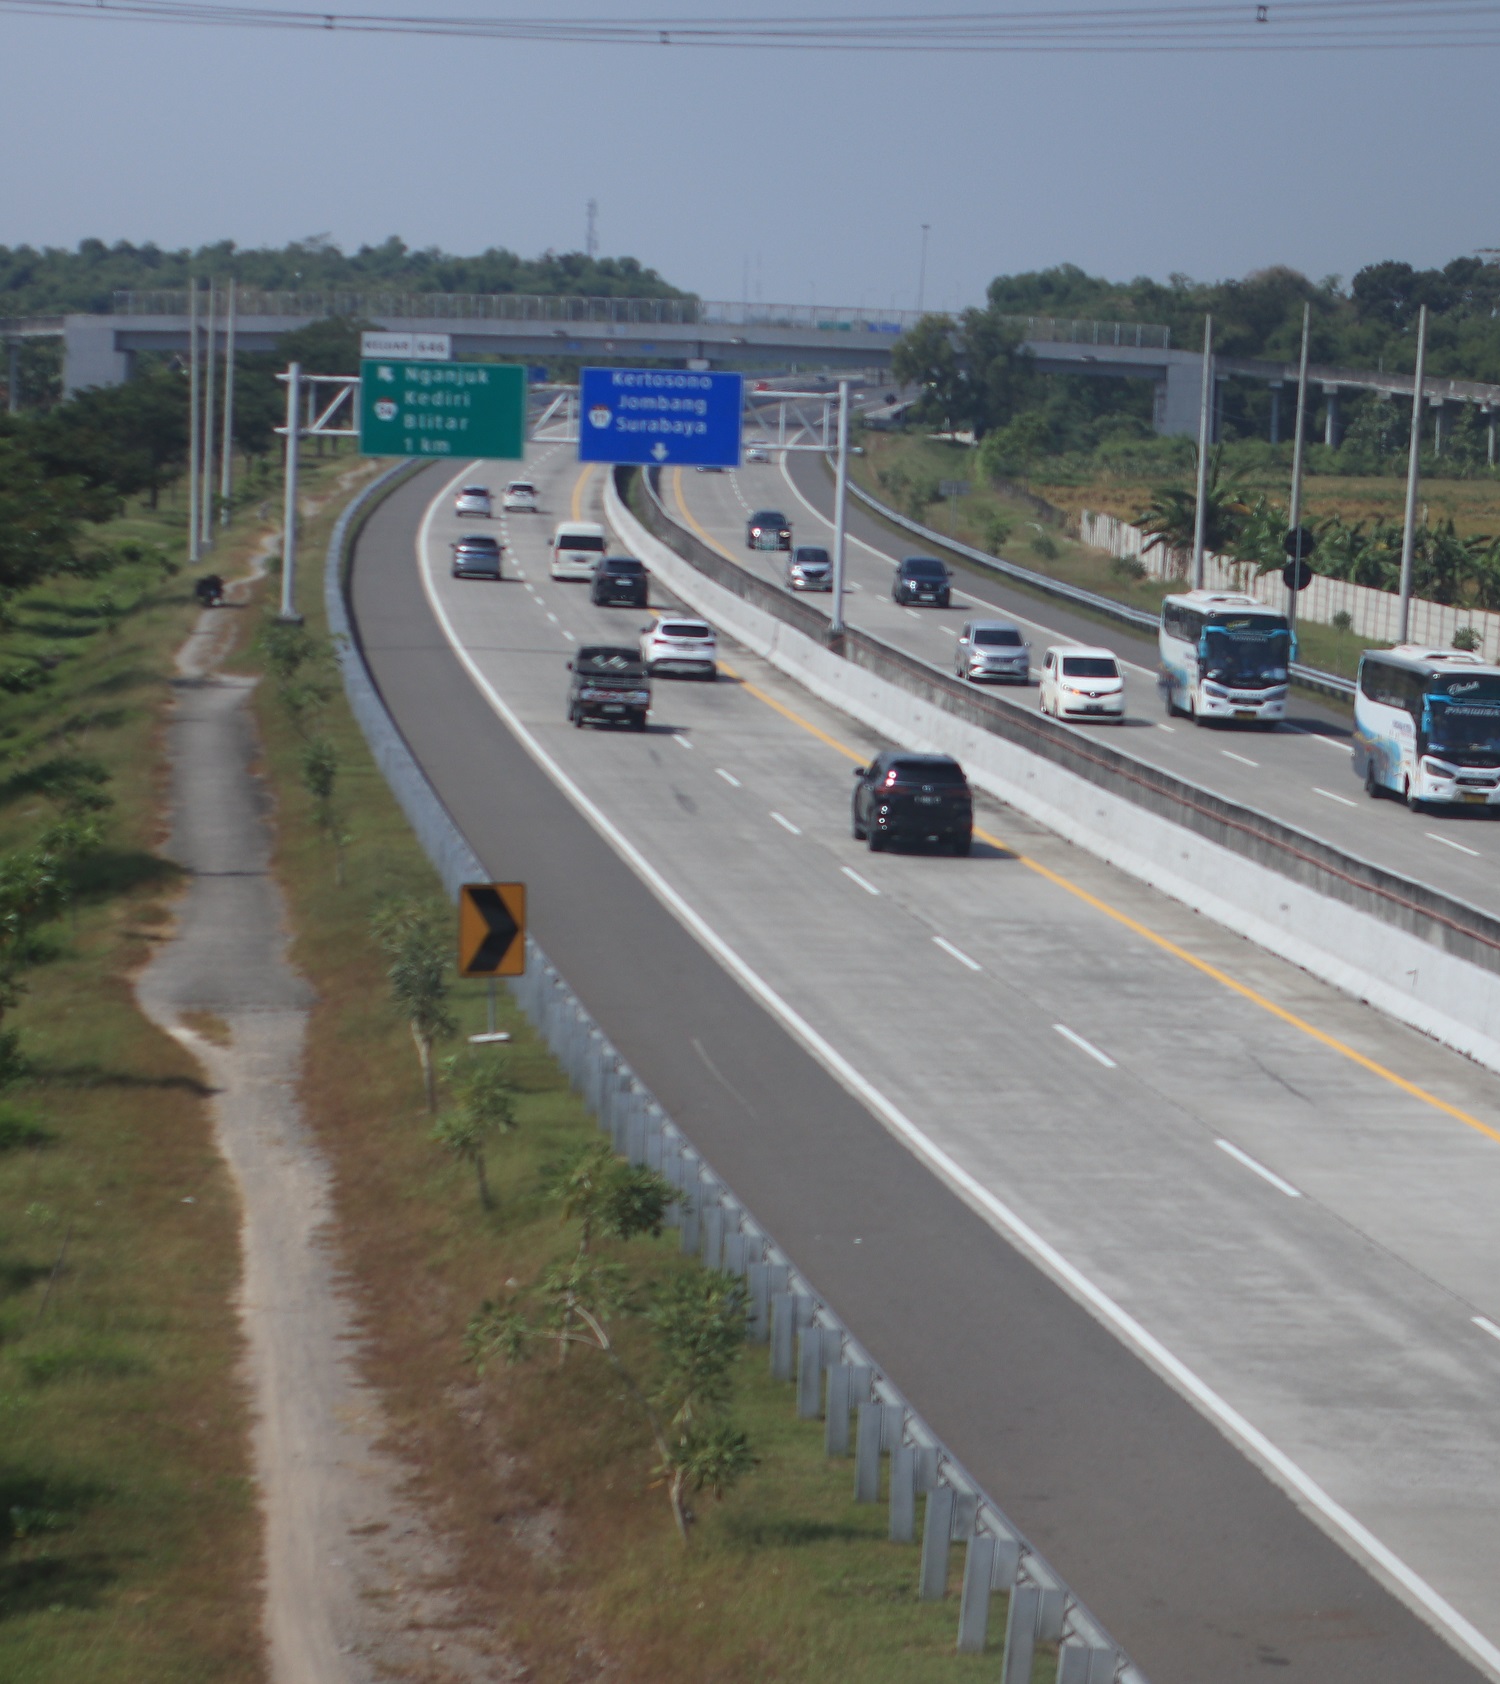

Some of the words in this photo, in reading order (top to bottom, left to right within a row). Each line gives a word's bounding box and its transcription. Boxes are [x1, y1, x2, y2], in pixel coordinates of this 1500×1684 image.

[404, 366, 489, 387] Nganjuk
[612, 372, 713, 390] Kertosono
[404, 390, 472, 407] Kediri
[617, 394, 708, 417] Jombang
[403, 413, 469, 431] Blitar
[615, 416, 708, 438] Surabaya
[404, 437, 413, 452] 1
[420, 436, 450, 453] km
